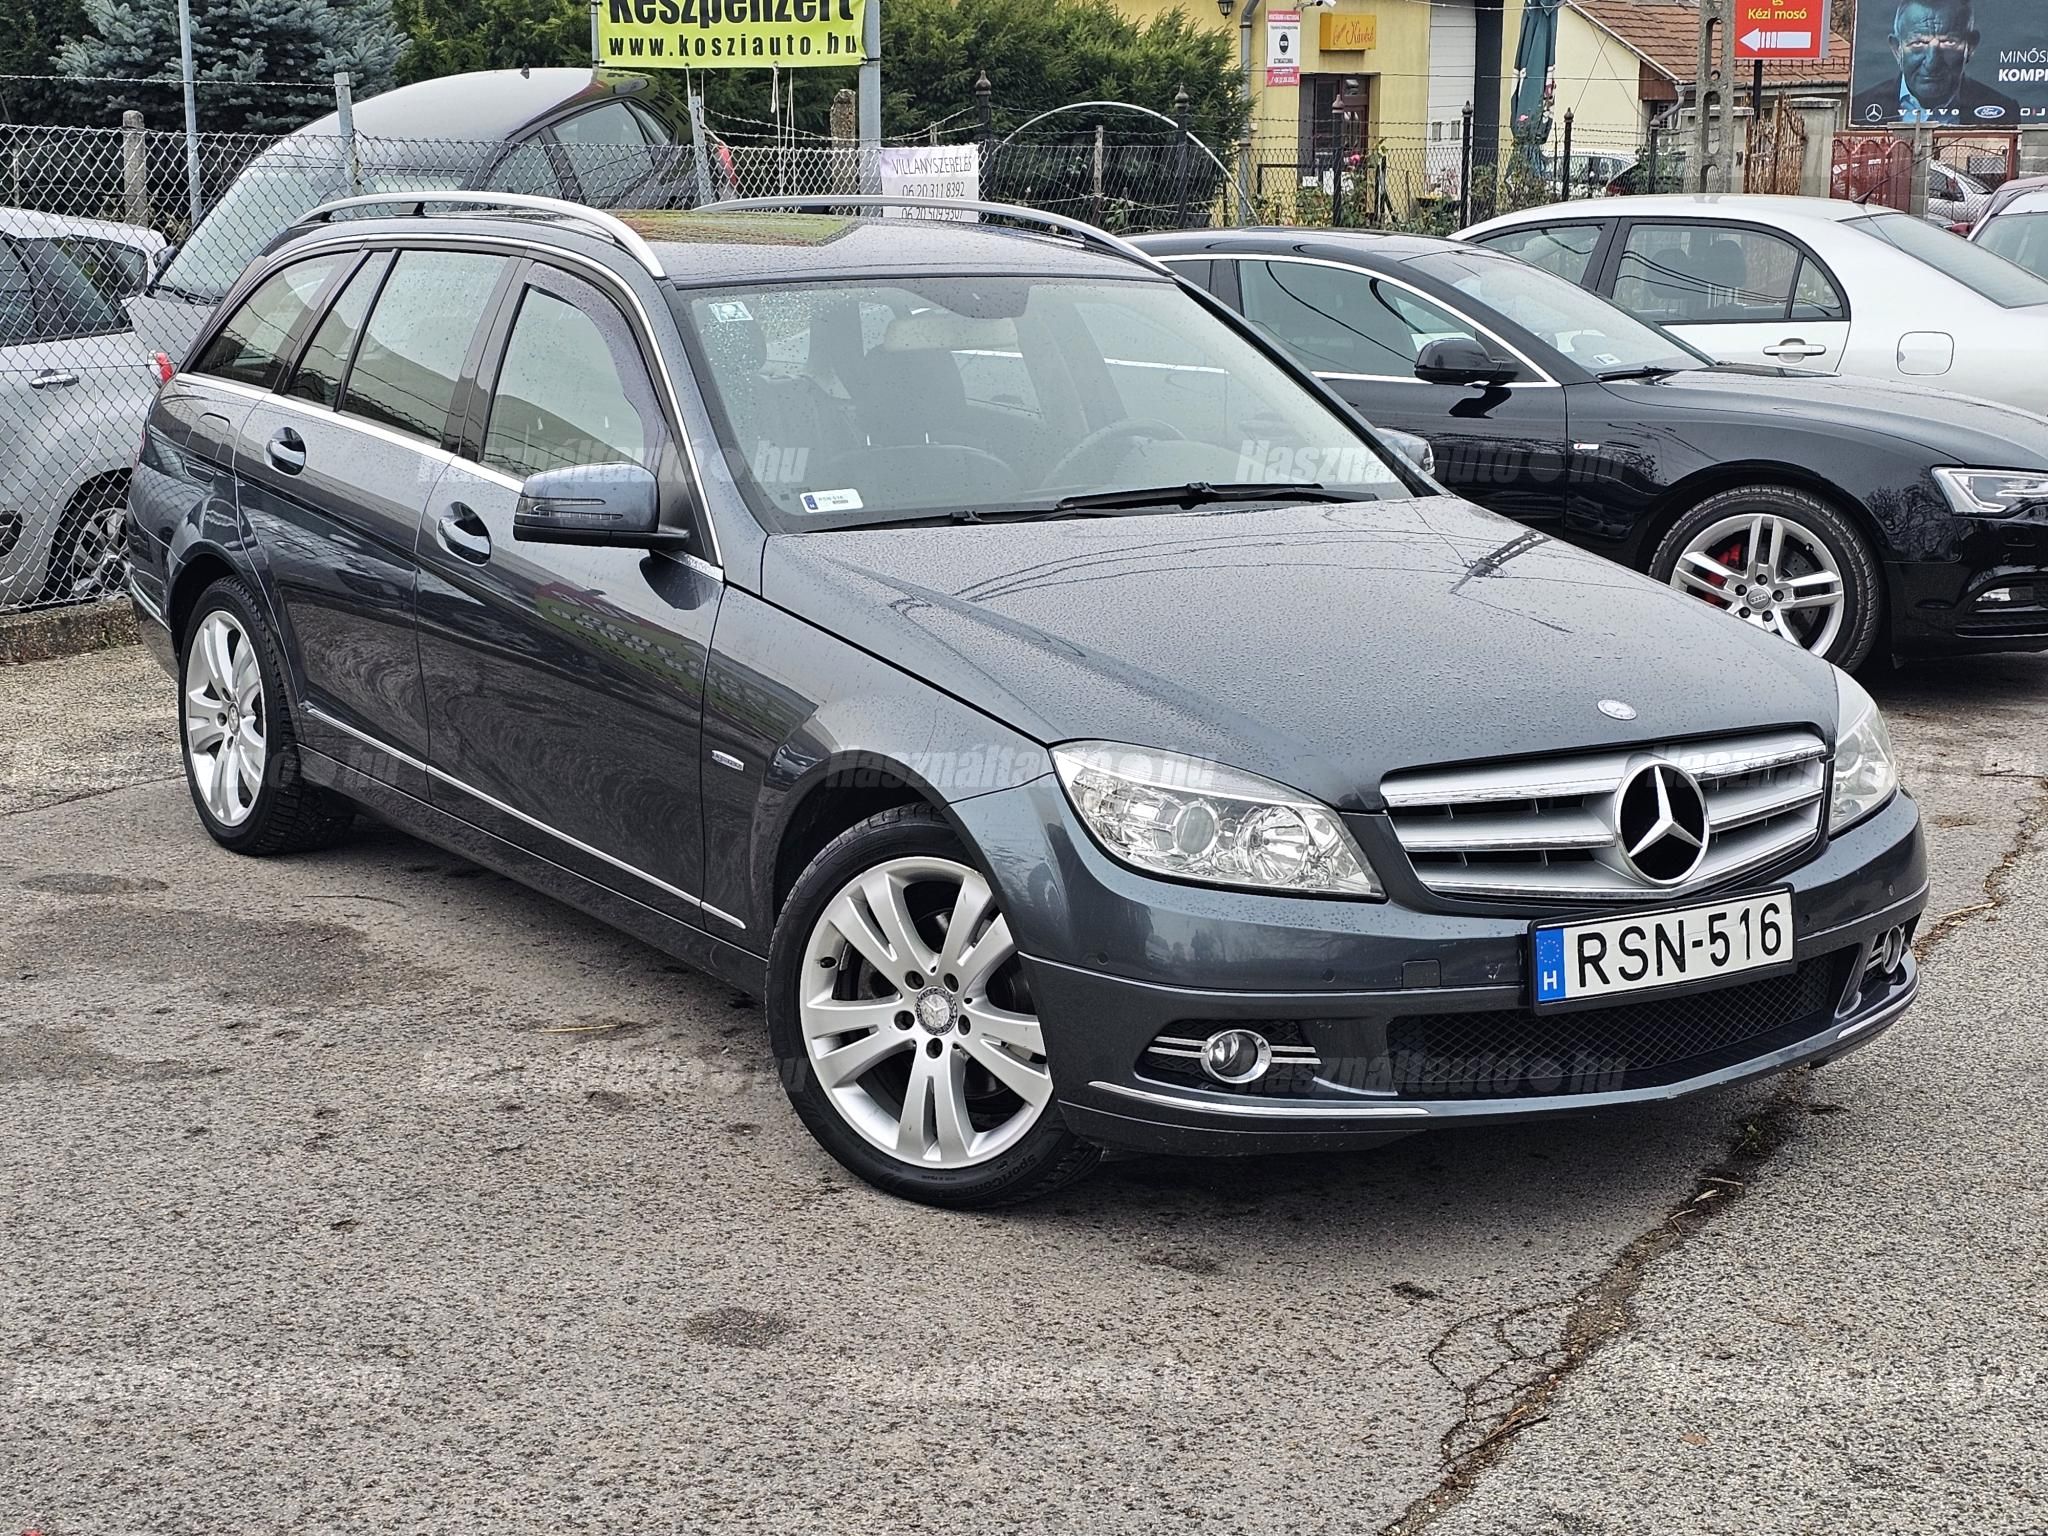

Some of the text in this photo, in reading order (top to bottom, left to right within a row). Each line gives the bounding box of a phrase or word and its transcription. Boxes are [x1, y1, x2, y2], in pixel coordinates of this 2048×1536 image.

[1748, 8, 1807, 20] Kézi mosó
[609, 32, 857, 57] www.kosziauto.hu
[1897, 108, 1960, 116] VOLVO
[902, 184, 915, 198] 06
[916, 183, 928, 198] 20
[1543, 902, 1782, 992] H RSN-516
